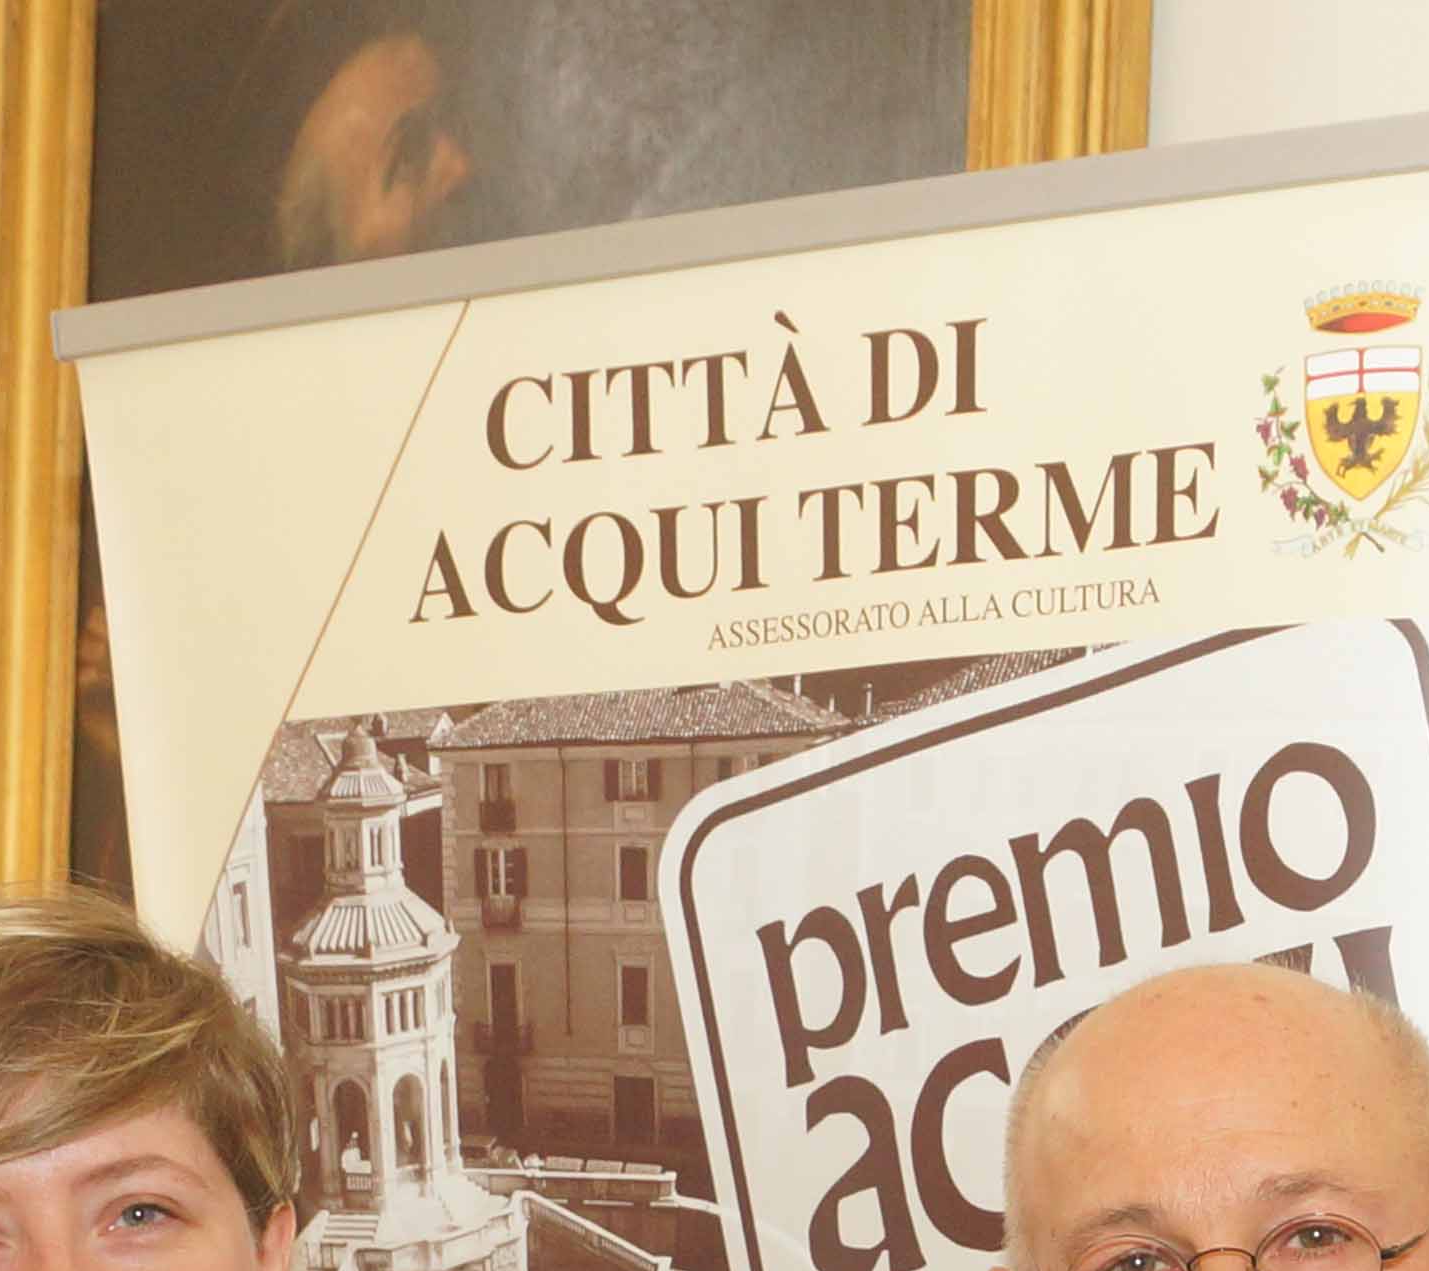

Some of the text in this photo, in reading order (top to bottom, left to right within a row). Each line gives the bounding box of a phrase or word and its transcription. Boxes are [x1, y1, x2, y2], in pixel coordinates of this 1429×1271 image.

[485, 310, 989, 470] CITTÀ DI
[407, 441, 1223, 628] ACQUI TERME
[706, 577, 1162, 651] ASSESSORATO ALLA CULTURA
[755, 740, 1377, 1088] premio
